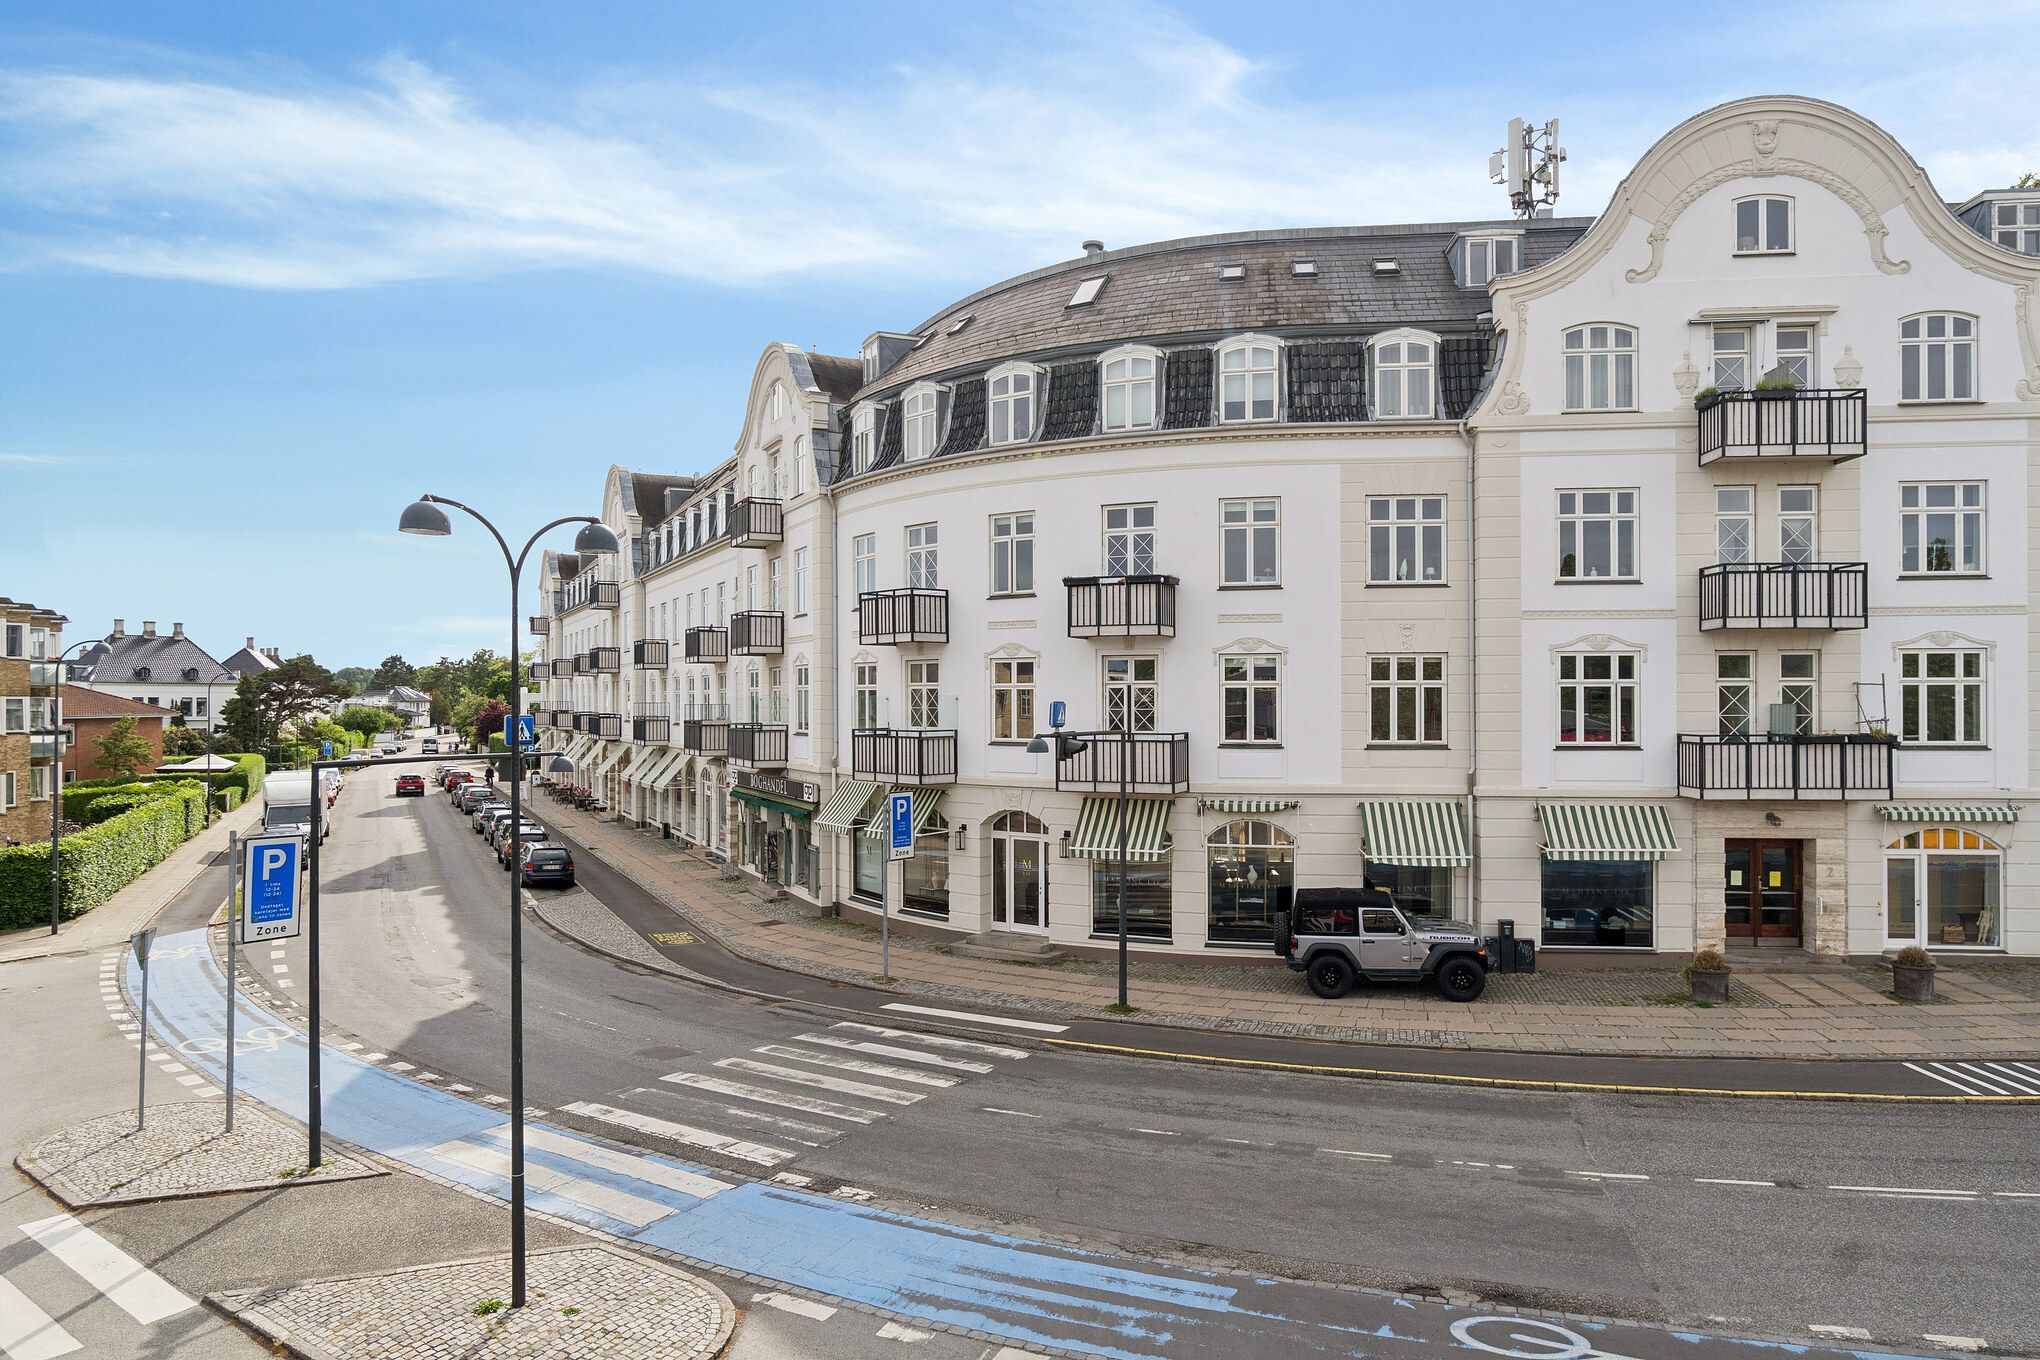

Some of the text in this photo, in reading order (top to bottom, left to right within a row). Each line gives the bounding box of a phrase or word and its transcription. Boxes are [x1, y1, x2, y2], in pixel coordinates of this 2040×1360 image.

[750, 774, 788, 795] BOGHANDEL
[896, 799, 908, 821] P
[262, 848, 287, 881] P
[256, 925, 287, 936] Zone
